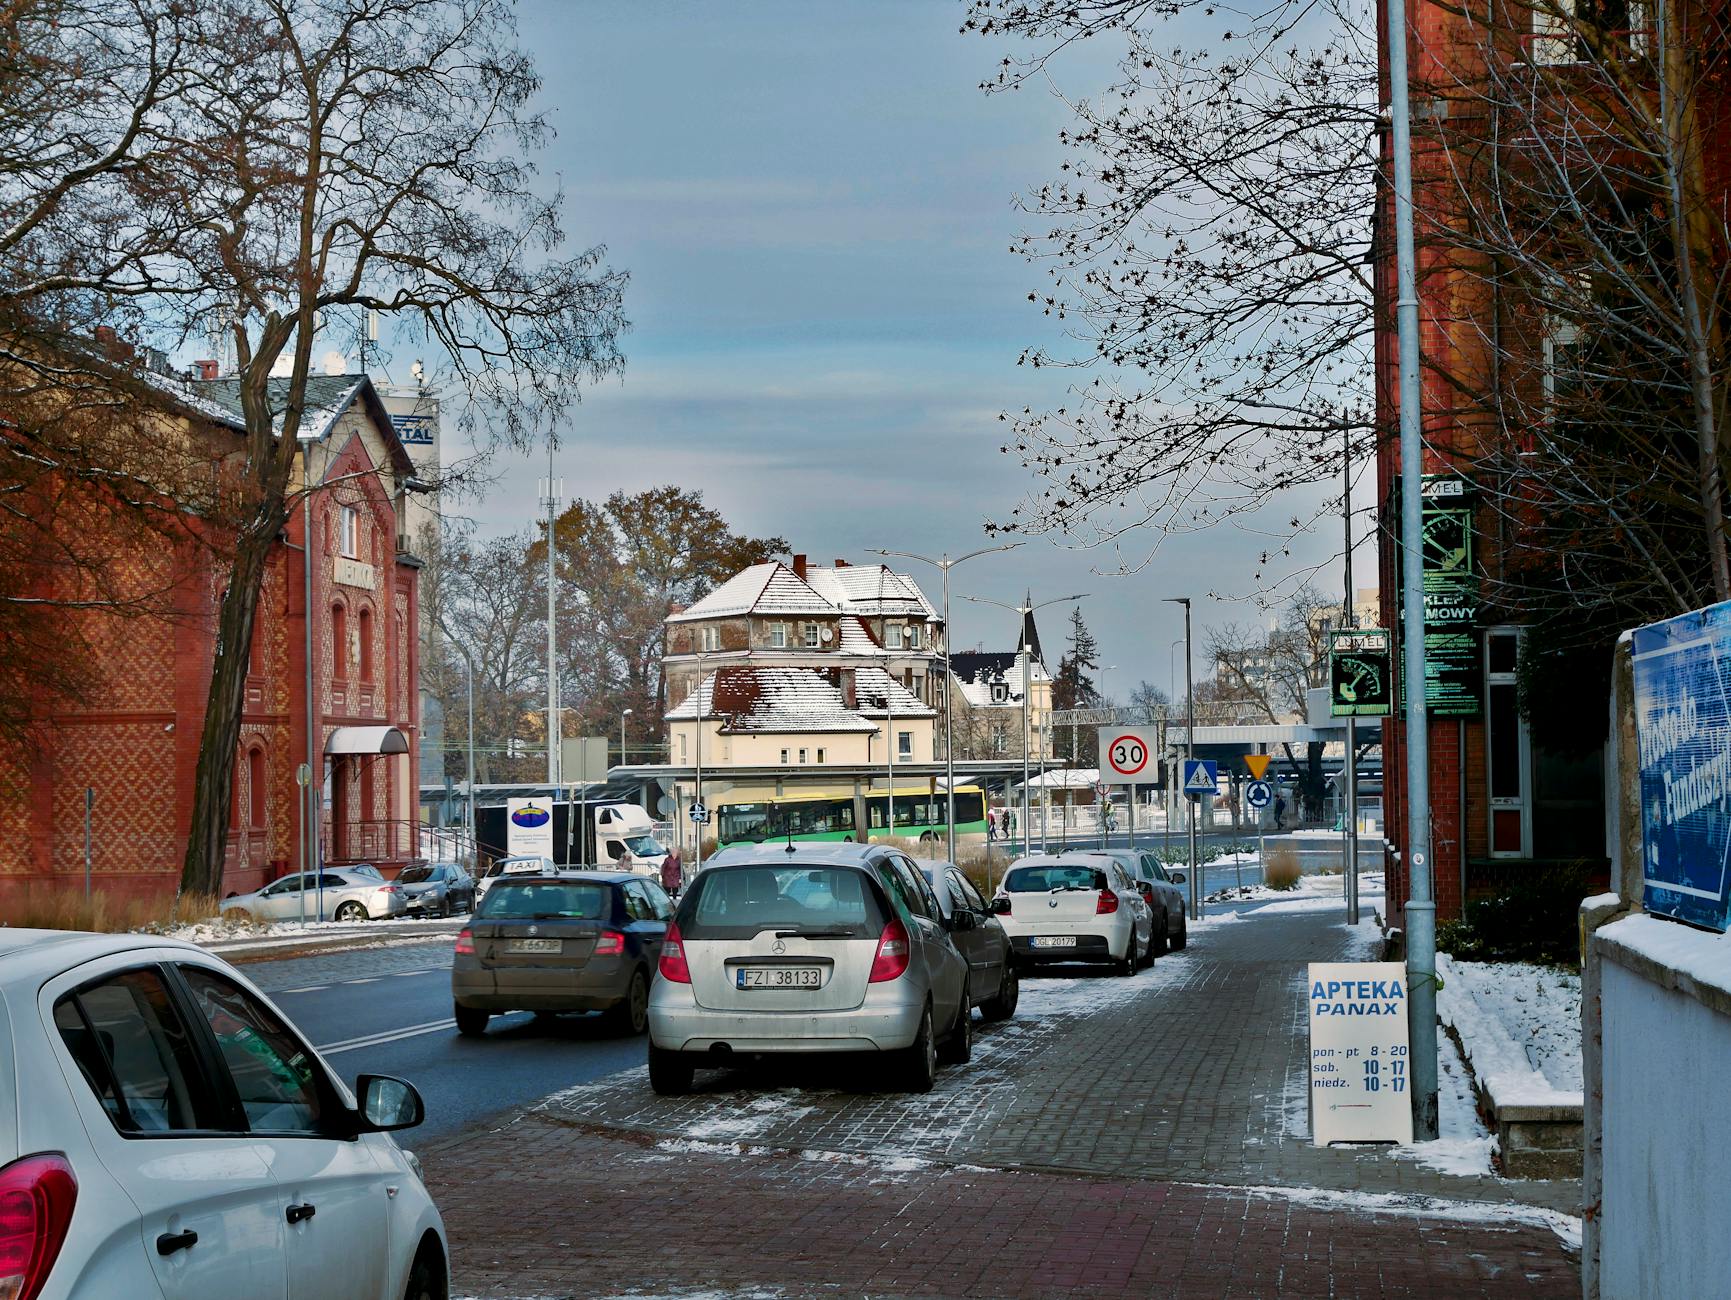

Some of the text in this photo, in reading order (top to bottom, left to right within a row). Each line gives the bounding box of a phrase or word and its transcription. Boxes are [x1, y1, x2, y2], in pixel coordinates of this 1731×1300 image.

[1680, 687, 1696, 742] do
[1114, 745, 1143, 764] 30
[510, 861, 536, 870] TAXI
[1052, 937, 1076, 946] 20179
[745, 971, 818, 985] FZI 38133
[1311, 981, 1404, 1000] APTEKA
[1316, 1002, 1398, 1016] PANAX
[1313, 1049, 1334, 1059] pon
[1346, 1048, 1360, 1059] pt
[1371, 1046, 1378, 1056] 8
[1390, 1046, 1407, 1056] 20
[1313, 1062, 1339, 1072] sob.
[1363, 1060, 1379, 1075] 10
[1390, 1060, 1405, 1075] 17
[1314, 1077, 1350, 1088] niedz.
[1363, 1076, 1380, 1091] 10
[1391, 1077, 1405, 1092] 17
